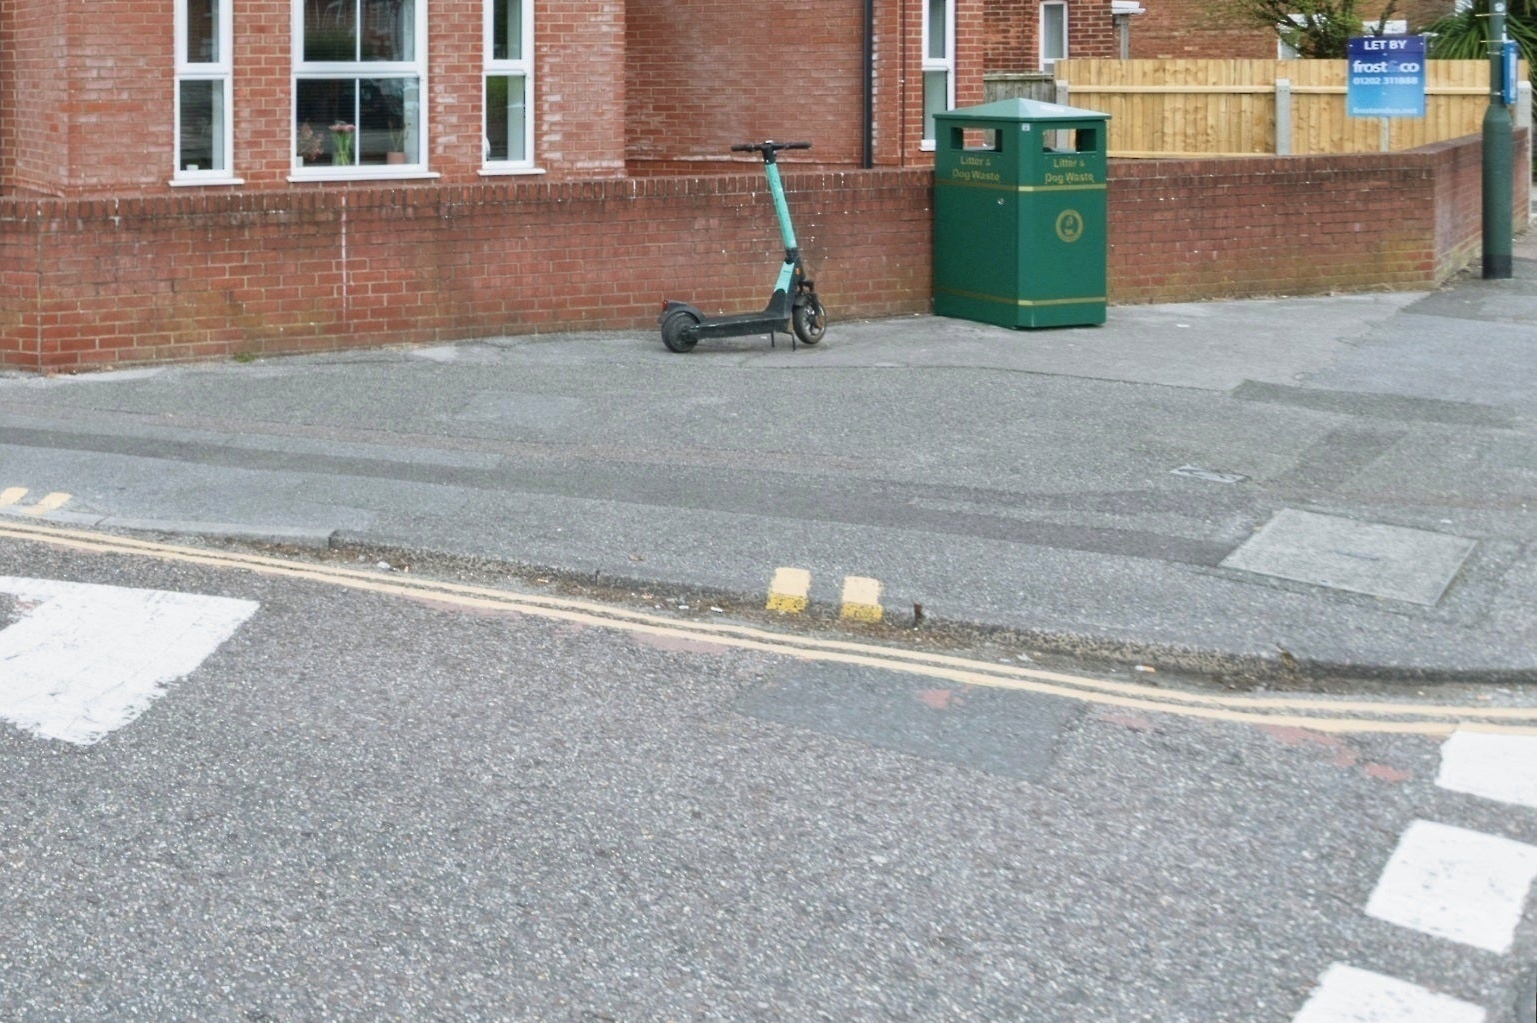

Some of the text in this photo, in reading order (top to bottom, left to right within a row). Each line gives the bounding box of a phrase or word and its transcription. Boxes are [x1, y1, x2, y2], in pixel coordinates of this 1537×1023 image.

[1364, 40, 1407, 50] LET BY
[1352, 77, 1381, 85] 01202
[960, 156, 983, 166] Litter
[1053, 158, 1077, 168] Litter
[952, 168, 1000, 182] Dog Waste
[1045, 172, 1095, 184] Dog Waste
